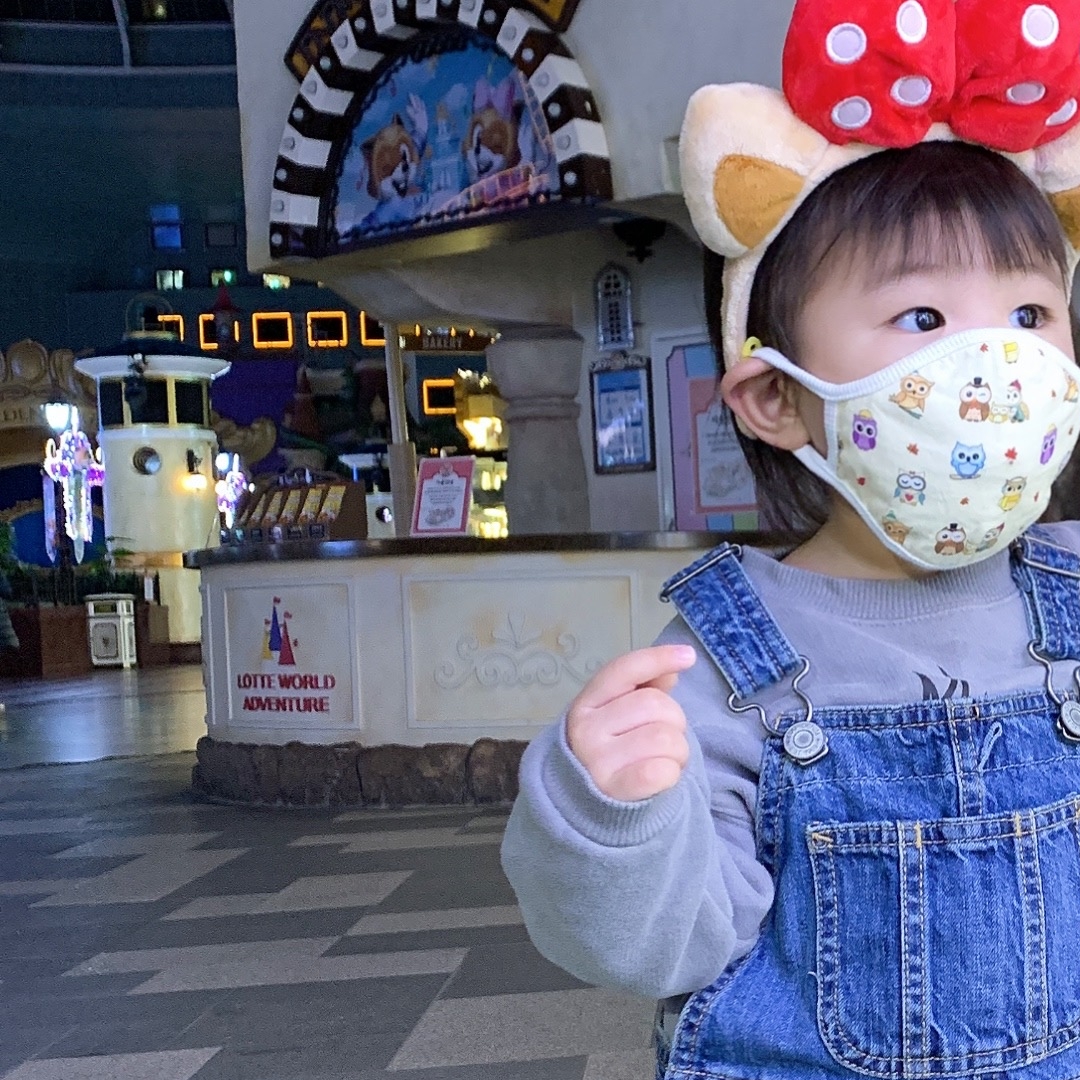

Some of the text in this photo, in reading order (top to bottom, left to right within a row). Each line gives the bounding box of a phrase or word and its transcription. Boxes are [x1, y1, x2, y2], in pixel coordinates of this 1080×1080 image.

[237, 673, 336, 690] LOTTE WORLD
[242, 696, 330, 713] ADVENTURE
